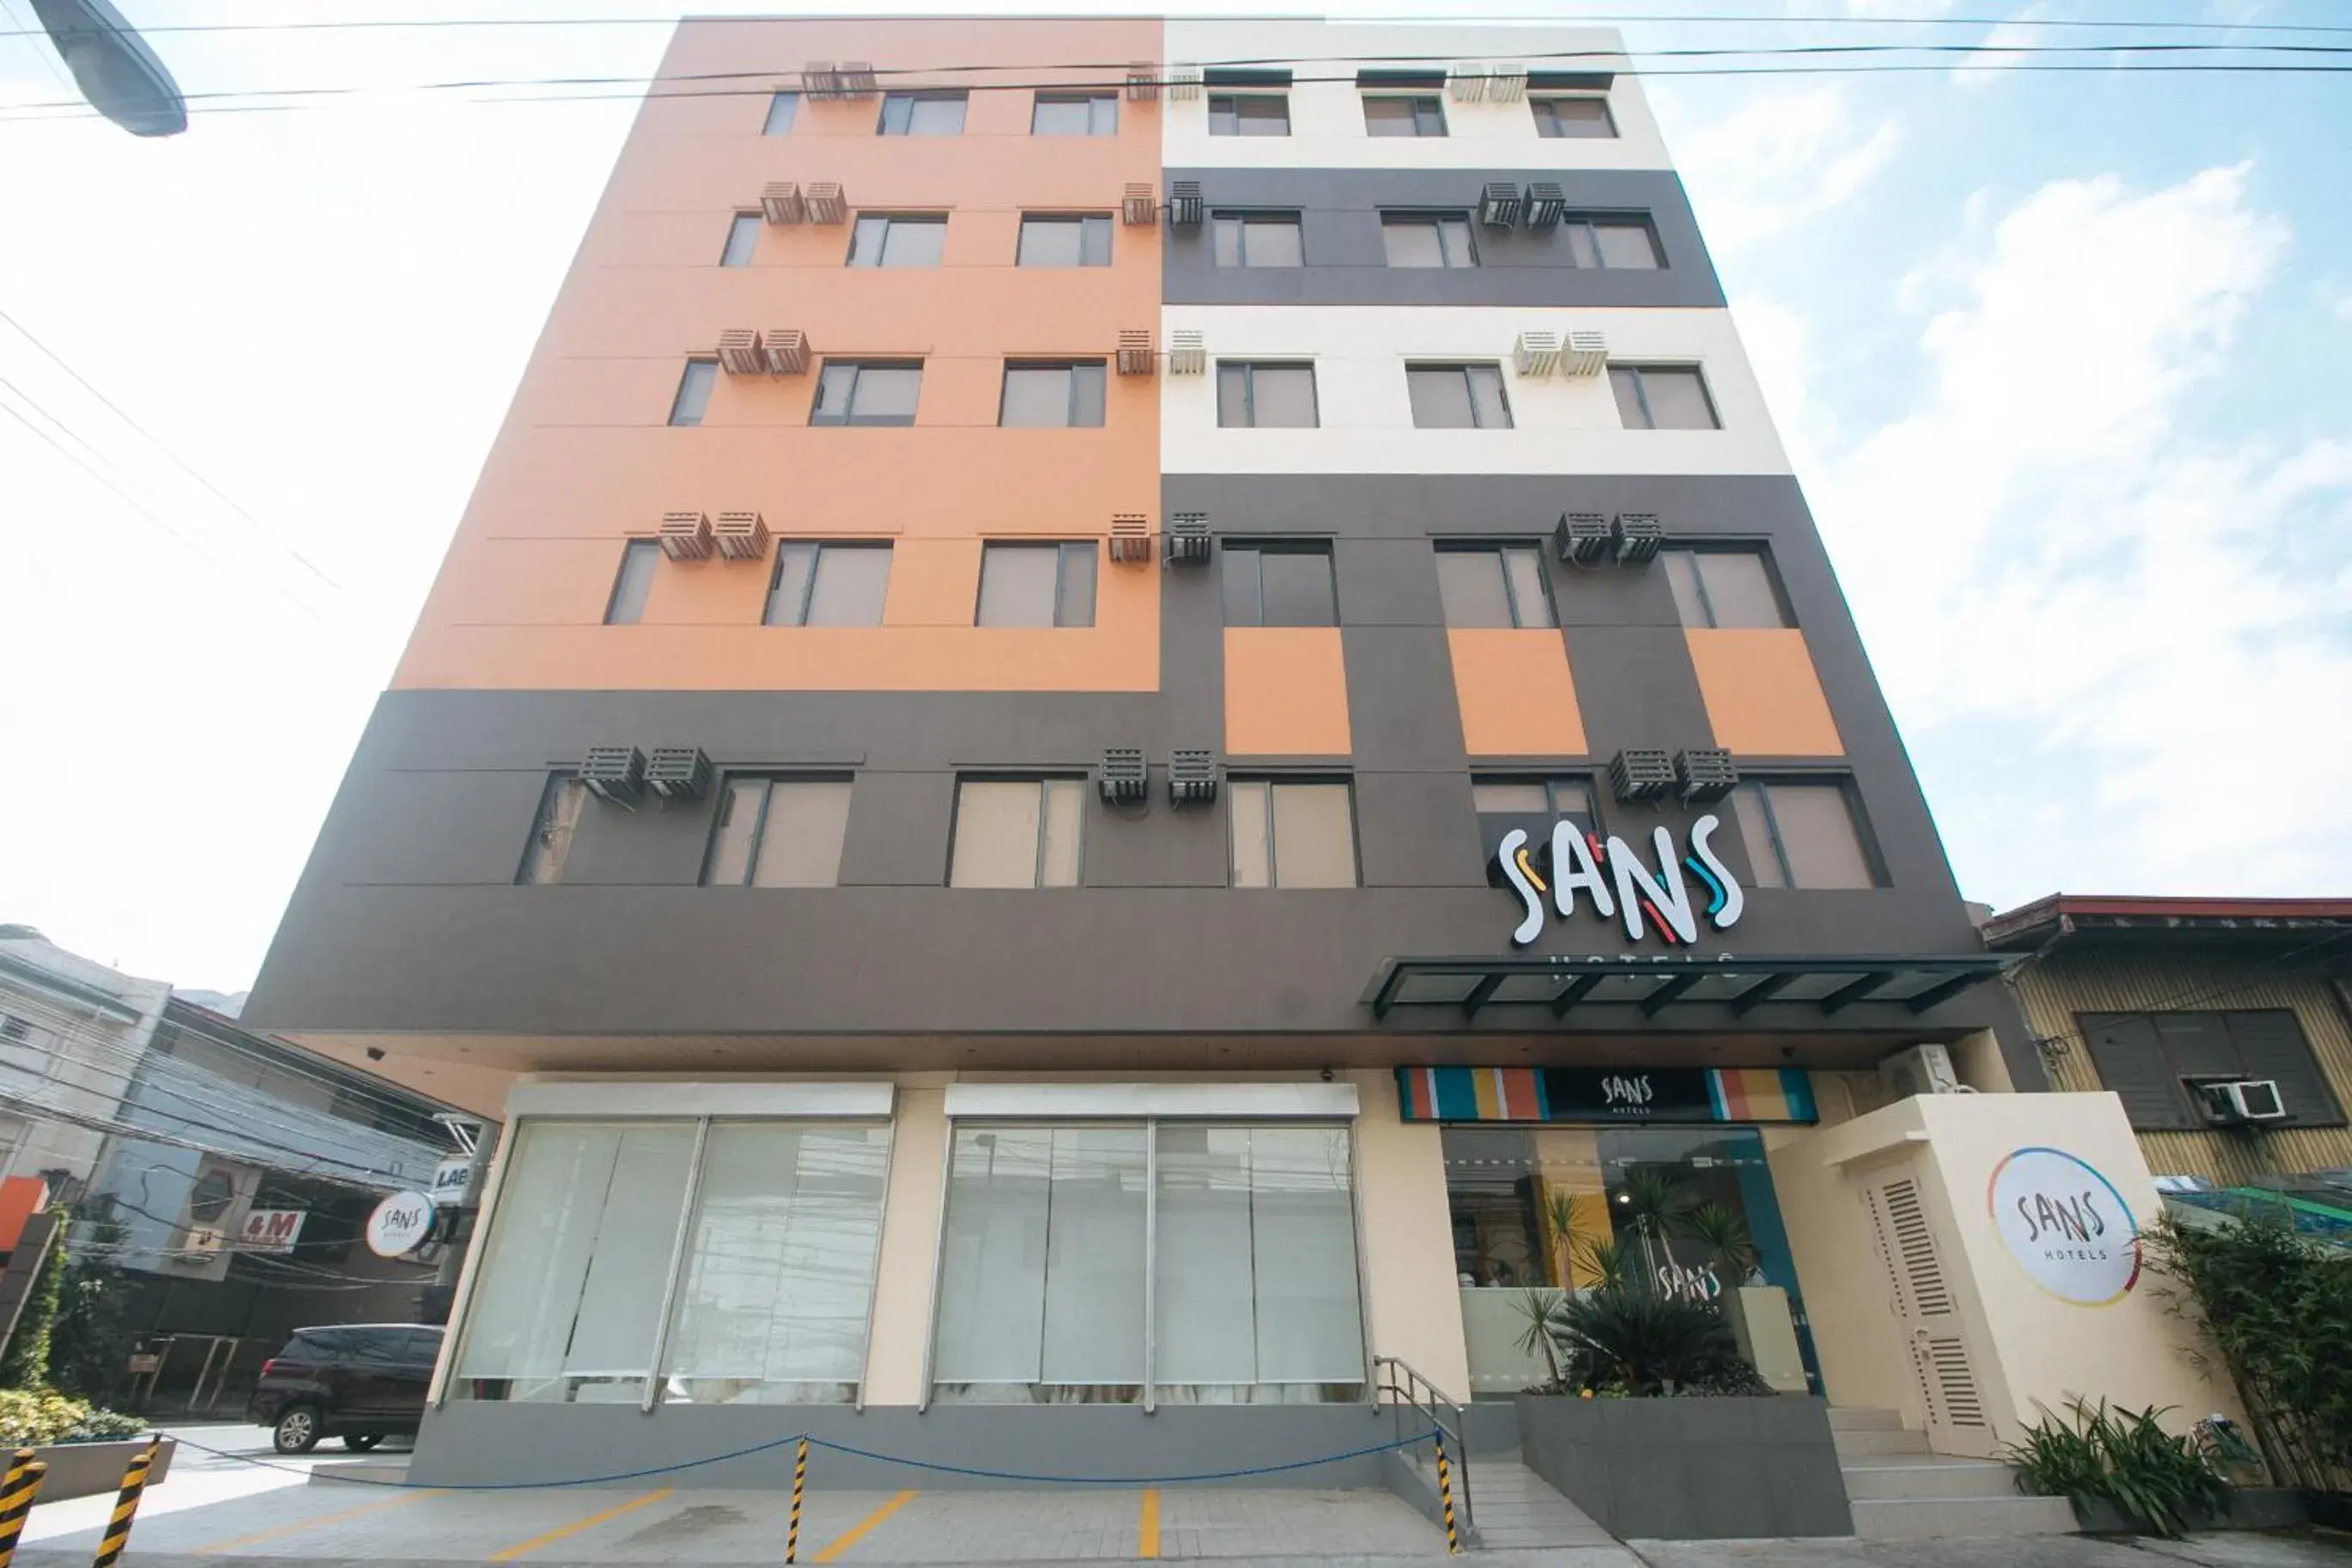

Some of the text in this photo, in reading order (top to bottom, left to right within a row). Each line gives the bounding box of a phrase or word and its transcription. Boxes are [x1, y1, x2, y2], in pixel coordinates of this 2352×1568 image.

[1498, 813, 1744, 946] SANS
[1602, 1075, 1653, 1104] SANS
[382, 1208, 422, 1229] SANS
[2018, 1191, 2104, 1242] SANS
[2044, 1250, 2107, 1260] HOTELS
